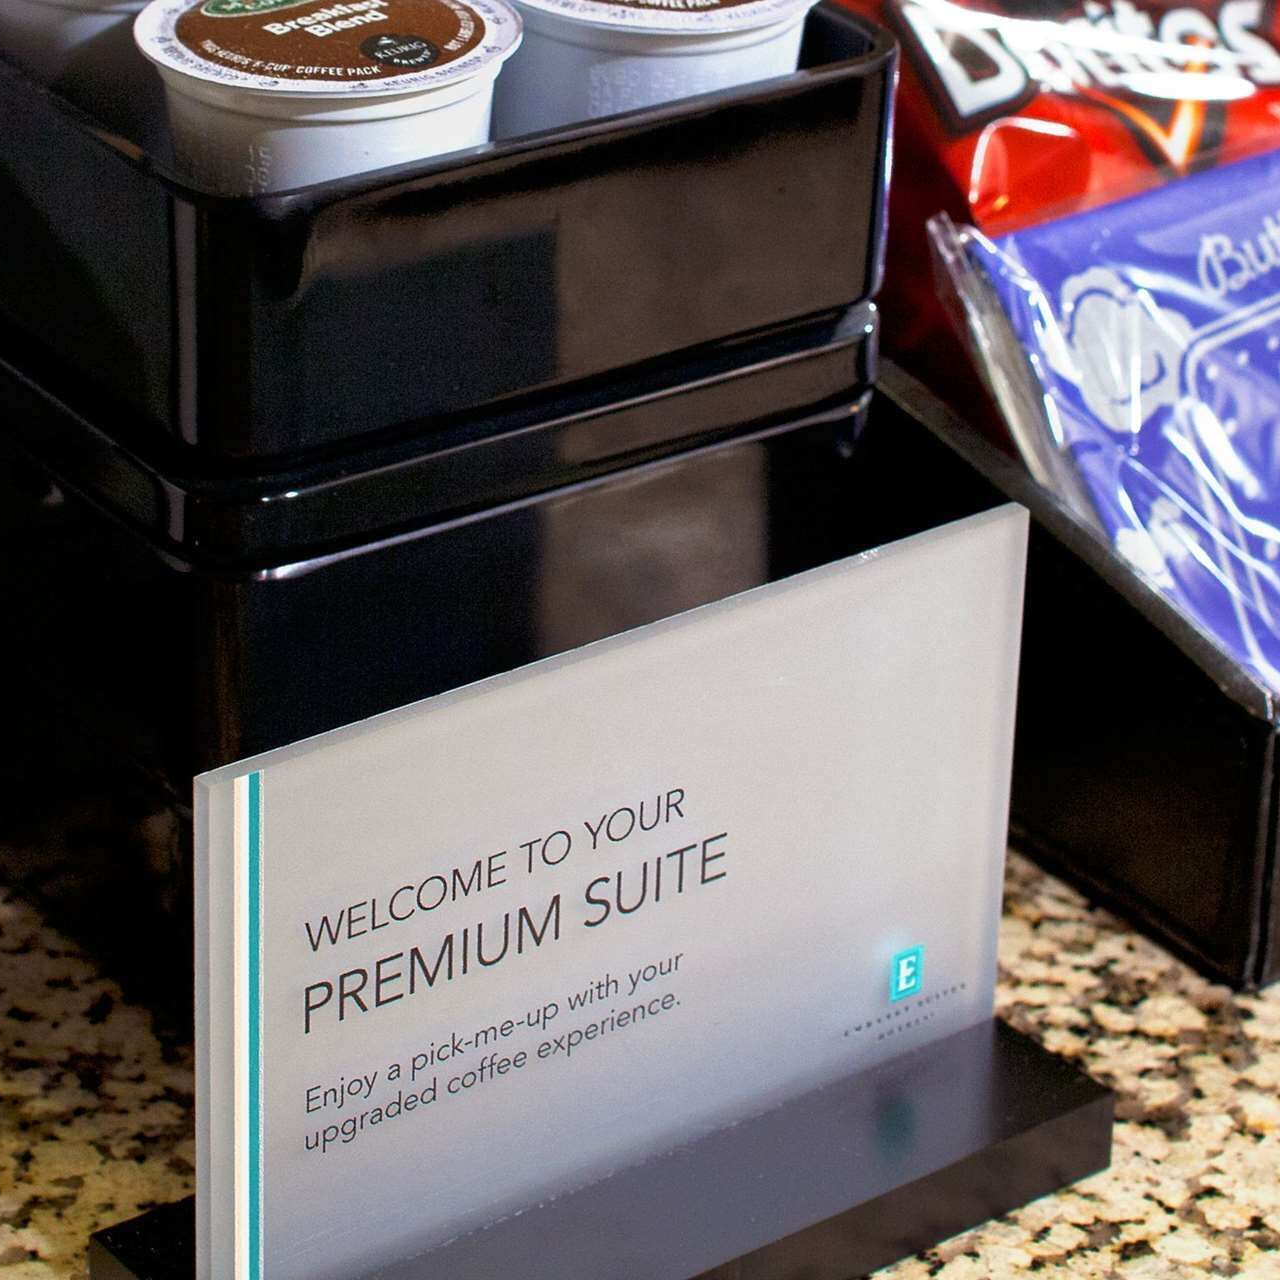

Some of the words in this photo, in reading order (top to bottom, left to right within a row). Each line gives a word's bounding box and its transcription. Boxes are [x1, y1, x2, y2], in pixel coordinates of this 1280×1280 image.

[296, 65, 344, 77] COFFEE
[346, 64, 383, 77] PACK
[305, 10, 391, 39] Blend
[374, 41, 428, 61] KEURIG
[304, 850, 508, 954] WELCOME
[519, 830, 573, 874] TO
[583, 787, 686, 851] YOUR
[303, 893, 562, 1035] PREMIUM
[582, 831, 729, 929] SUITE
[897, 954, 917, 992] E
[304, 1075, 438, 1154] upgraded
[446, 1049, 528, 1096] coffee
[536, 989, 683, 1061] experience.
[305, 1070, 378, 1114] Enjoy
[386, 1062, 402, 1082] a
[410, 1000, 560, 1082] pick-me-up
[566, 973, 620, 1012] with
[627, 950, 685, 992] your
